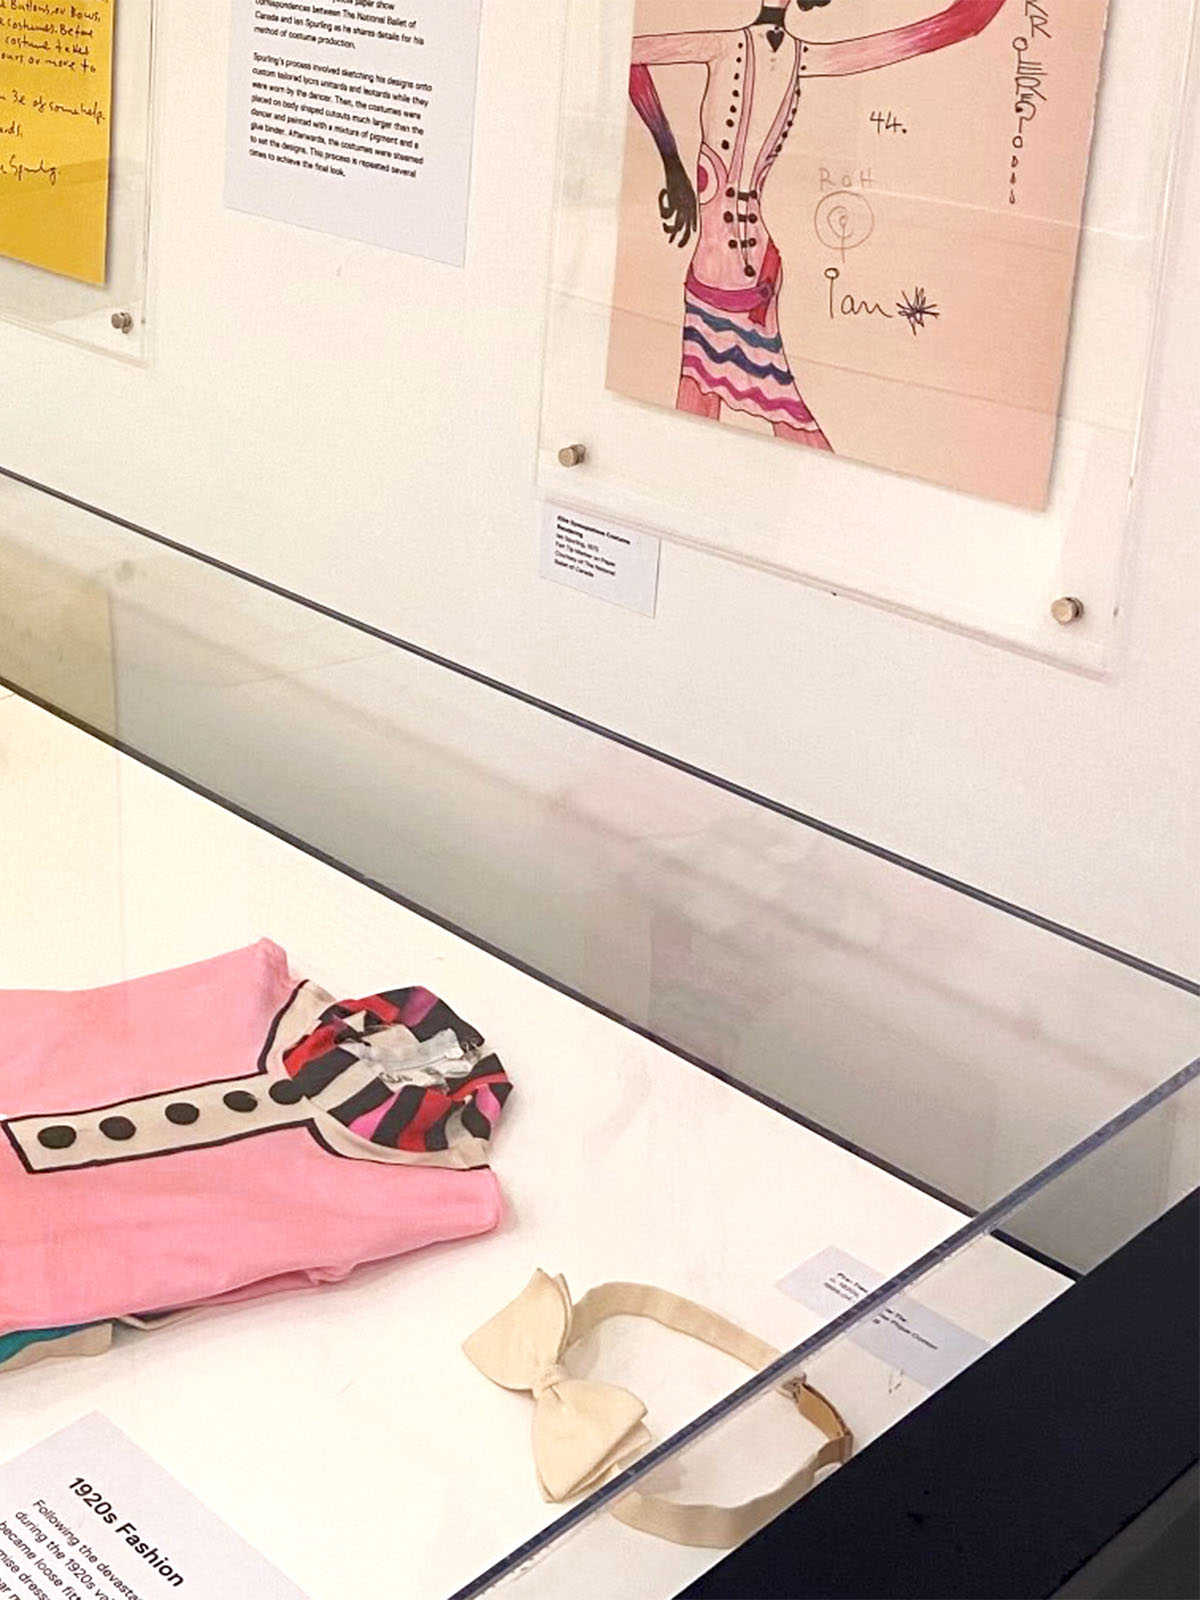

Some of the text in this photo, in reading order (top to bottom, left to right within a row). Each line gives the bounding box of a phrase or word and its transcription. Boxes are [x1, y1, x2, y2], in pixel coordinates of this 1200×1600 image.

[311, 5, 341, 17] between
[342, 9, 356, 20] The
[356, 11, 386, 24] National
[386, 15, 407, 27] Ballet
[407, 19, 417, 29] of
[375, 0, 395, 10] show
[253, 26, 355, 49] method of costume production.
[254, 11, 425, 46] Canada and Ian Spurling he shares details for his
[251, 67, 429, 107] custom tailored lycra unitards and leotards while they
[253, 52, 433, 92] Spurling's process involved sketching his designs onto
[250, 94, 424, 136] placed on body shaped cutouts much larger than the
[251, 81, 268, 90] were
[268, 85, 285, 93] worn
[285, 86, 295, 97] by
[295, 88, 307, 98] the
[354, 100, 367, 110] the
[367, 103, 402, 117] costumes
[402, 110, 421, 120] were
[250, 107, 413, 148] dancer and painted with mixture of pigment and
[250, 121, 264, 131] glue
[327, 137, 340, 147] the
[340, 141, 373, 154] costumes
[374, 149, 392, 158] were
[393, 152, 424, 165] steamed
[248, 148, 346, 177] times achieve the final look.
[257, 137, 268, 145] set
[268, 139, 280, 148] the
[309, 146, 324, 158] This
[324, 151, 351, 164] process
[358, 159, 390, 172] repeated
[390, 166, 417, 178] several
[14, 1511, 96, 1590] during the 1920s
[32, 1499, 138, 1600] Following the devasta
[69, 1477, 183, 1587] 1920s Fashion
[17, 1572, 50, 1600] dress
[33, 1557, 63, 1587] loose
